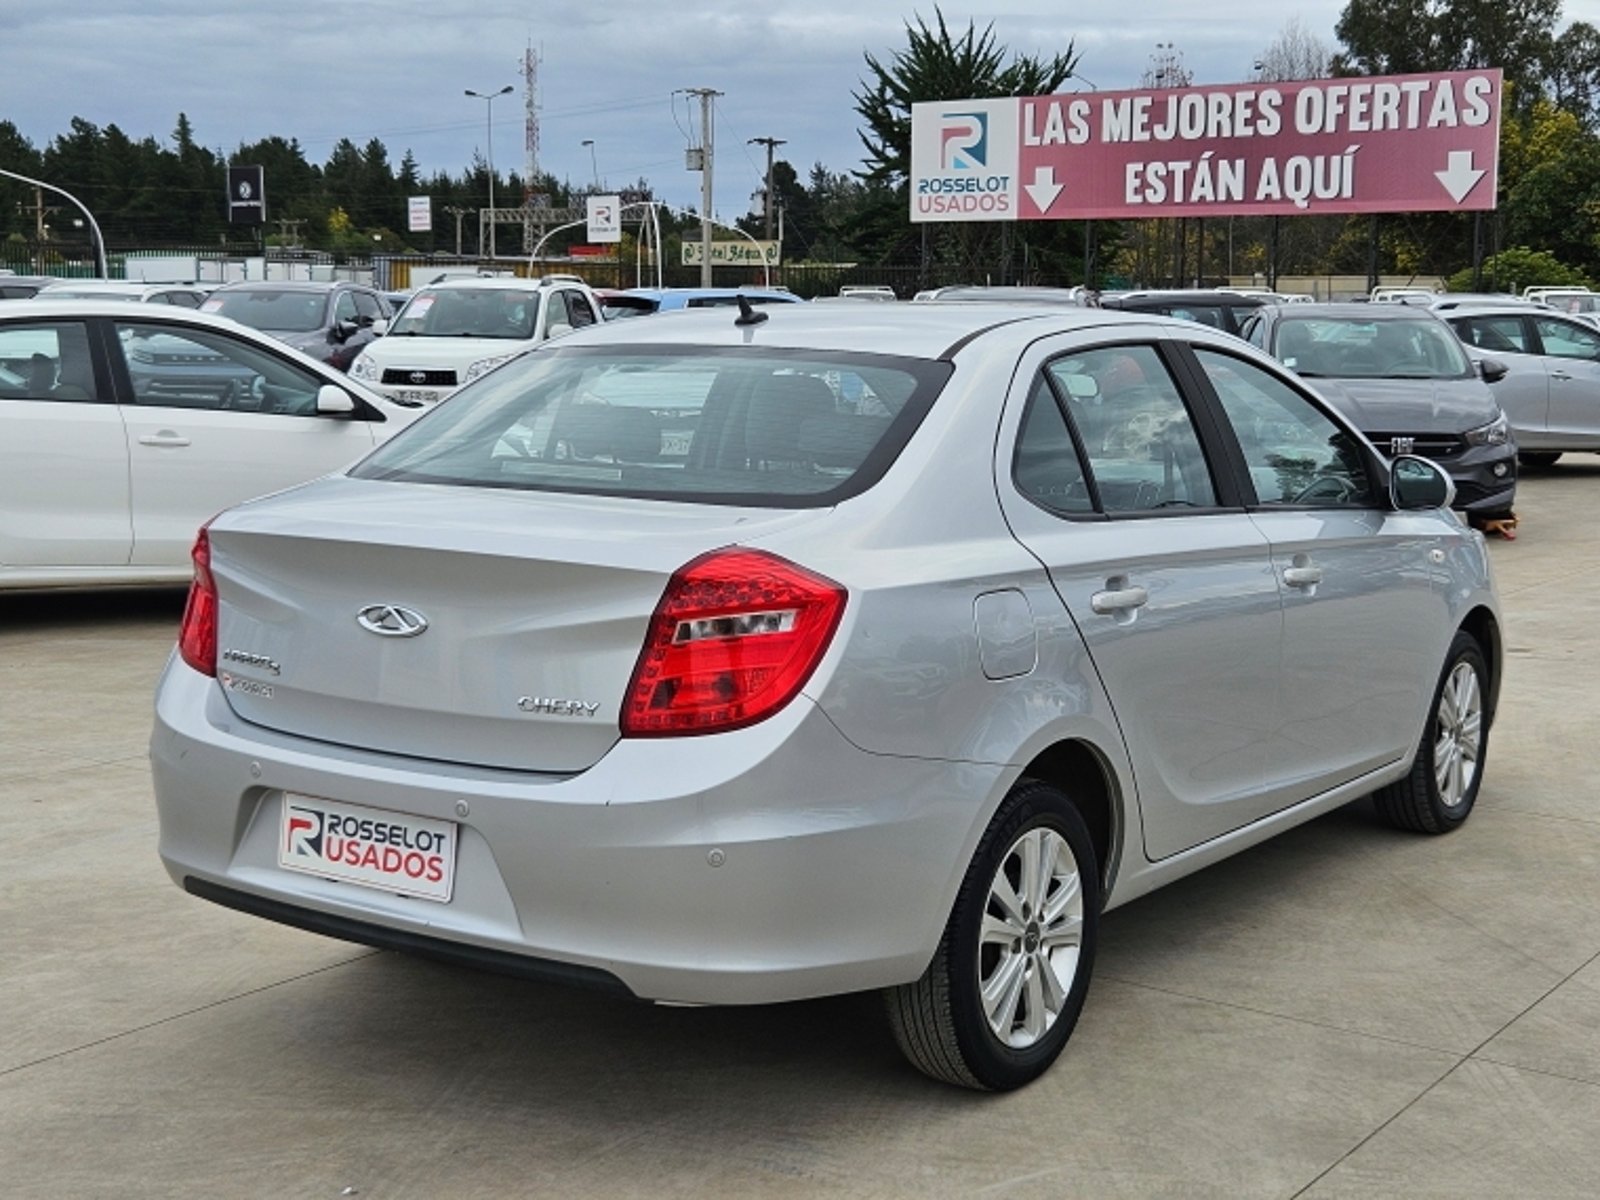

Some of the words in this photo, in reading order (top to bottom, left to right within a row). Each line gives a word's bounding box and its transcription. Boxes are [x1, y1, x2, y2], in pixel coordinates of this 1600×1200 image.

[1023, 99, 1091, 146] LAS
[1101, 88, 1283, 143] MEJORES
[1294, 76, 1492, 134] OFERTAS
[918, 176, 1010, 194] ROSSELOT
[1125, 151, 1246, 204] ESTÁN
[1255, 145, 1361, 208] AQUÍ
[918, 193, 1010, 213] USADOS
[1391, 437, 1415, 453] FIAT
[517, 695, 600, 717] CHERY
[327, 813, 446, 854] ROSSELOT
[325, 836, 444, 882] USADOS
